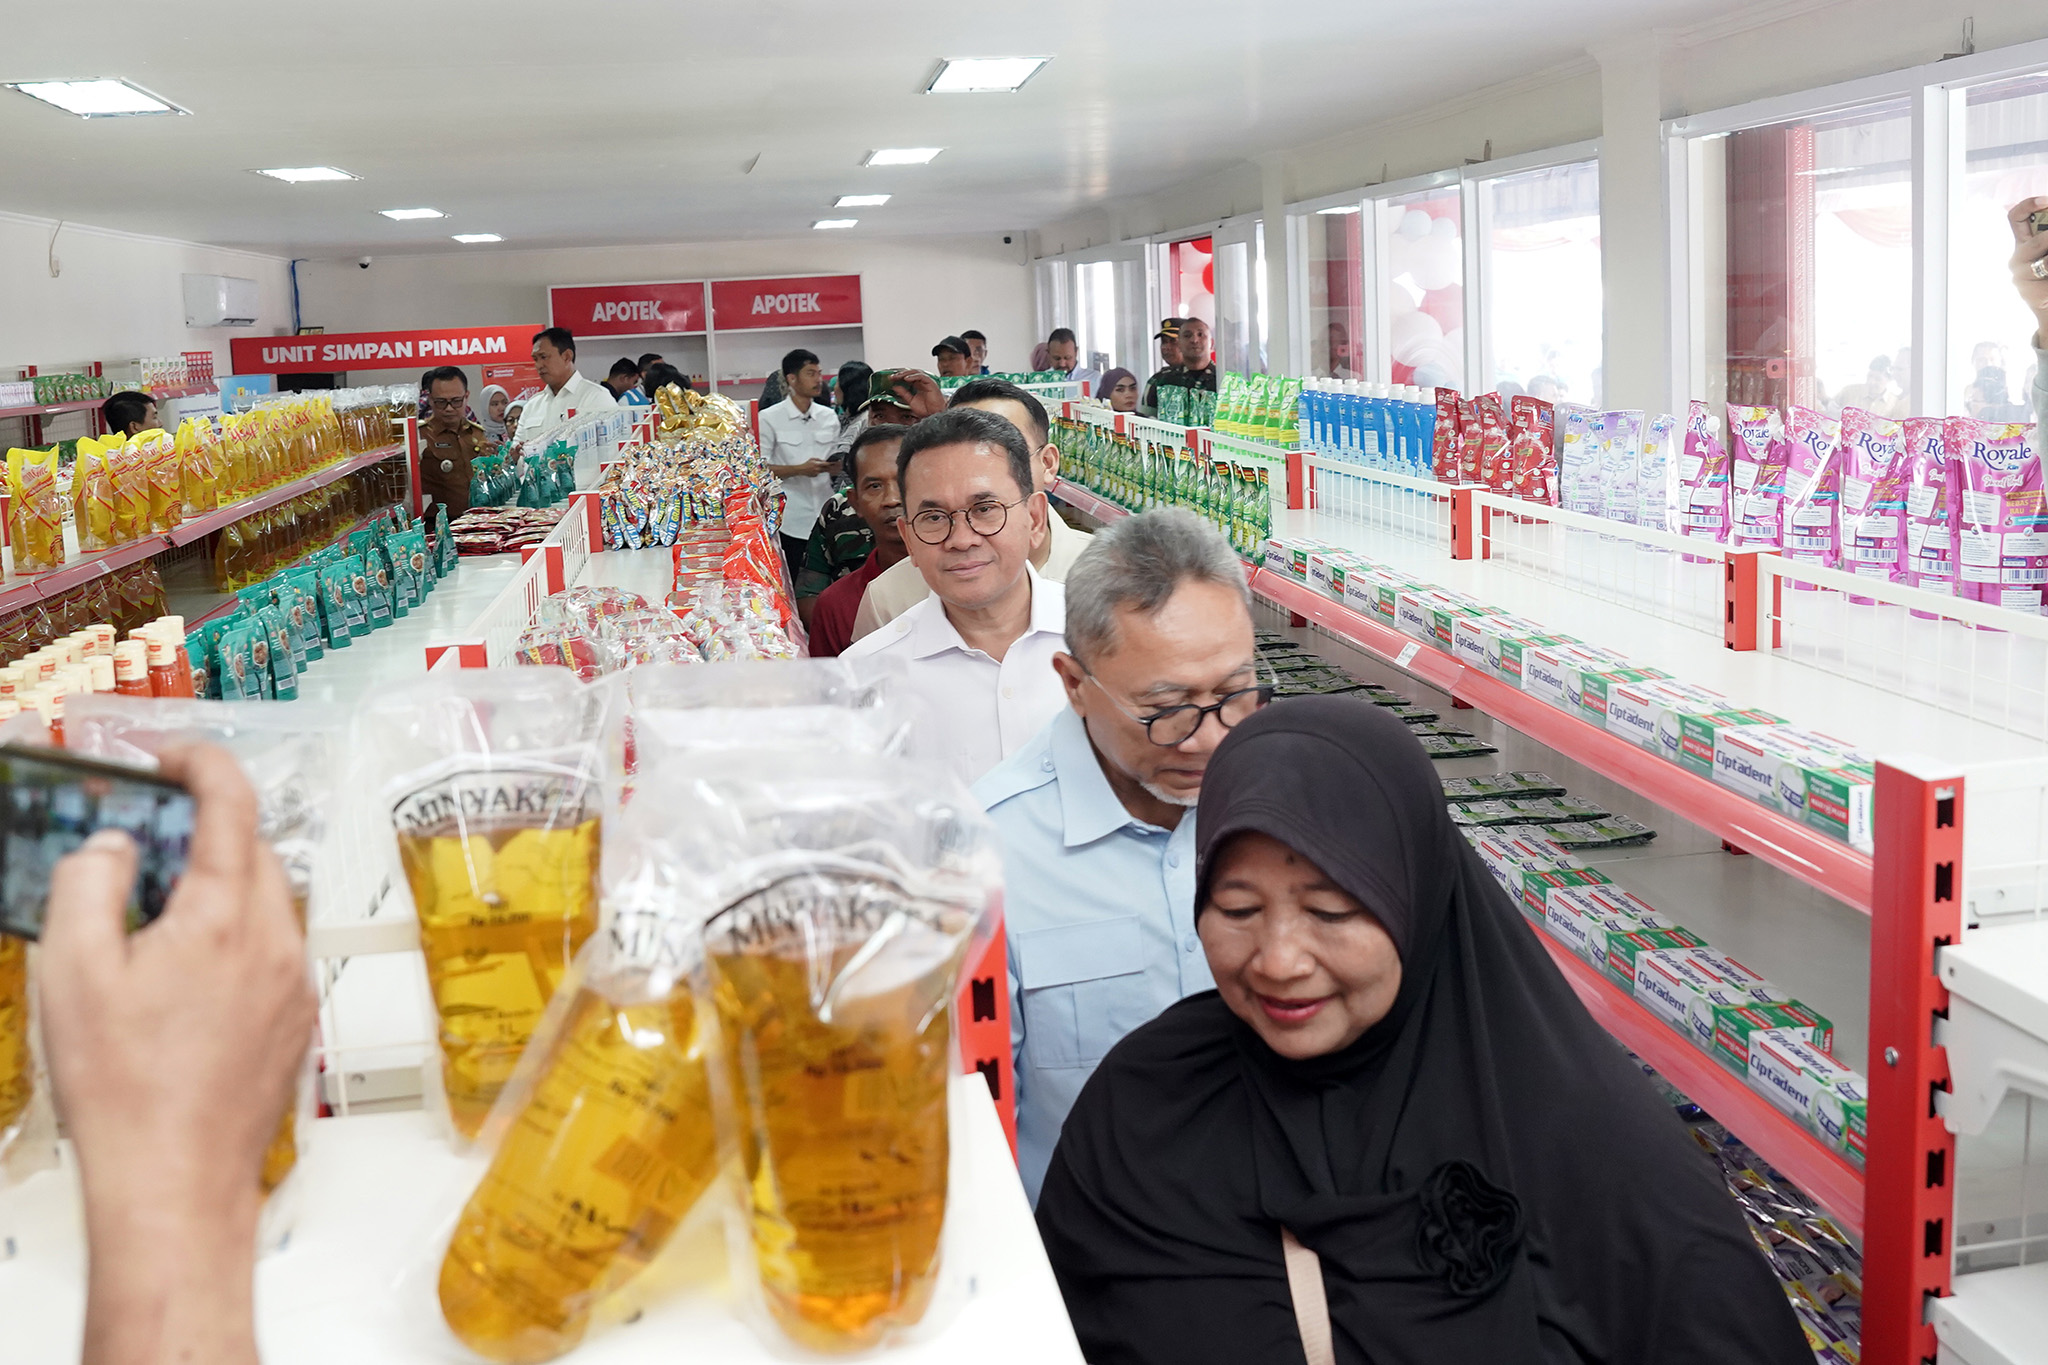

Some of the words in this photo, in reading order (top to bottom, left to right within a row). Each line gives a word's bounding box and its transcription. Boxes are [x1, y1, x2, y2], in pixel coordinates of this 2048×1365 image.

[592, 300, 664, 322] APOTEK
[751, 292, 821, 315] APOTEK
[262, 345, 316, 364] UNIT
[322, 339, 412, 362] SIMPAN
[418, 336, 507, 358] PINJAM
[1972, 440, 2031, 471] Royale
[1346, 584, 1368, 603] Ciptadent
[1400, 606, 1423, 627] Ciptadent
[1455, 633, 1485, 656] Ciptadent
[1528, 663, 1563, 690] Ciptadent
[1608, 702, 1656, 733] Ciptadent
[1716, 749, 1773, 788] Ciptadent
[1547, 905, 1586, 943] Ciptadent
[1651, 950, 1707, 985] Ciptadent
[1691, 948, 1749, 983] Ciptadent
[1637, 970, 1687, 1015] Ciptadent
[1763, 1030, 1833, 1074] Ciptadent
[1750, 1053, 1810, 1108] Ciptadent
